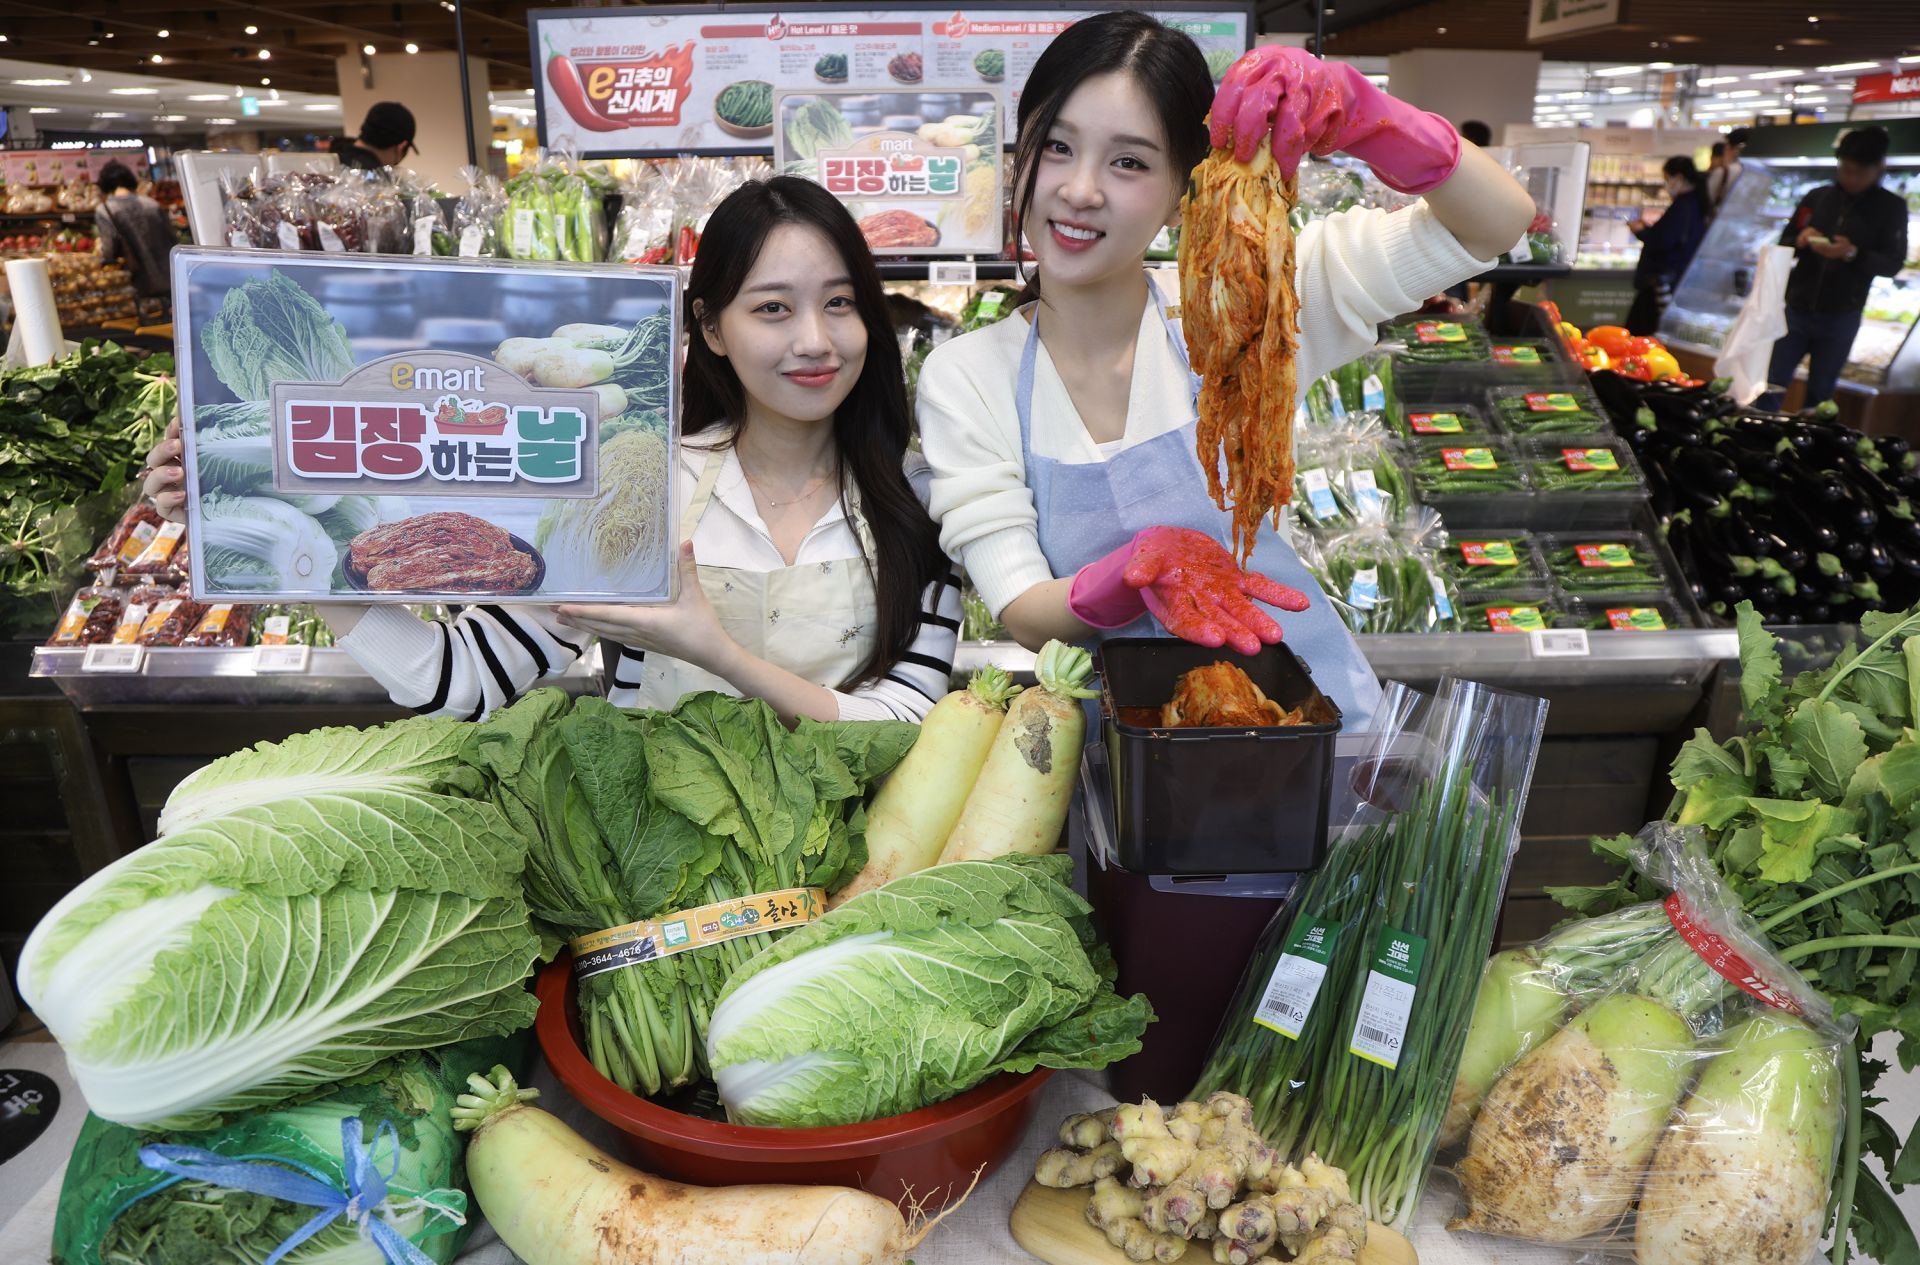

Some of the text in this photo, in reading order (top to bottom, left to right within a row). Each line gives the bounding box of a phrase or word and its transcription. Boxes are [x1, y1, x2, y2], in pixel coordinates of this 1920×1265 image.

[805, 25, 825, 34] Level
[849, 24, 858, 34] 맛
[971, 23, 1001, 33] Medium
[1002, 23, 1022, 33] Level
[607, 88, 678, 114] 신세계
[869, 137, 913, 152] emart
[826, 157, 958, 193] 김장 하는 날
[391, 362, 486, 392] emart
[291, 405, 582, 478] 김장 하는 날
[1310, 926, 1326, 936] 신선
[1392, 939, 1410, 954] 신선
